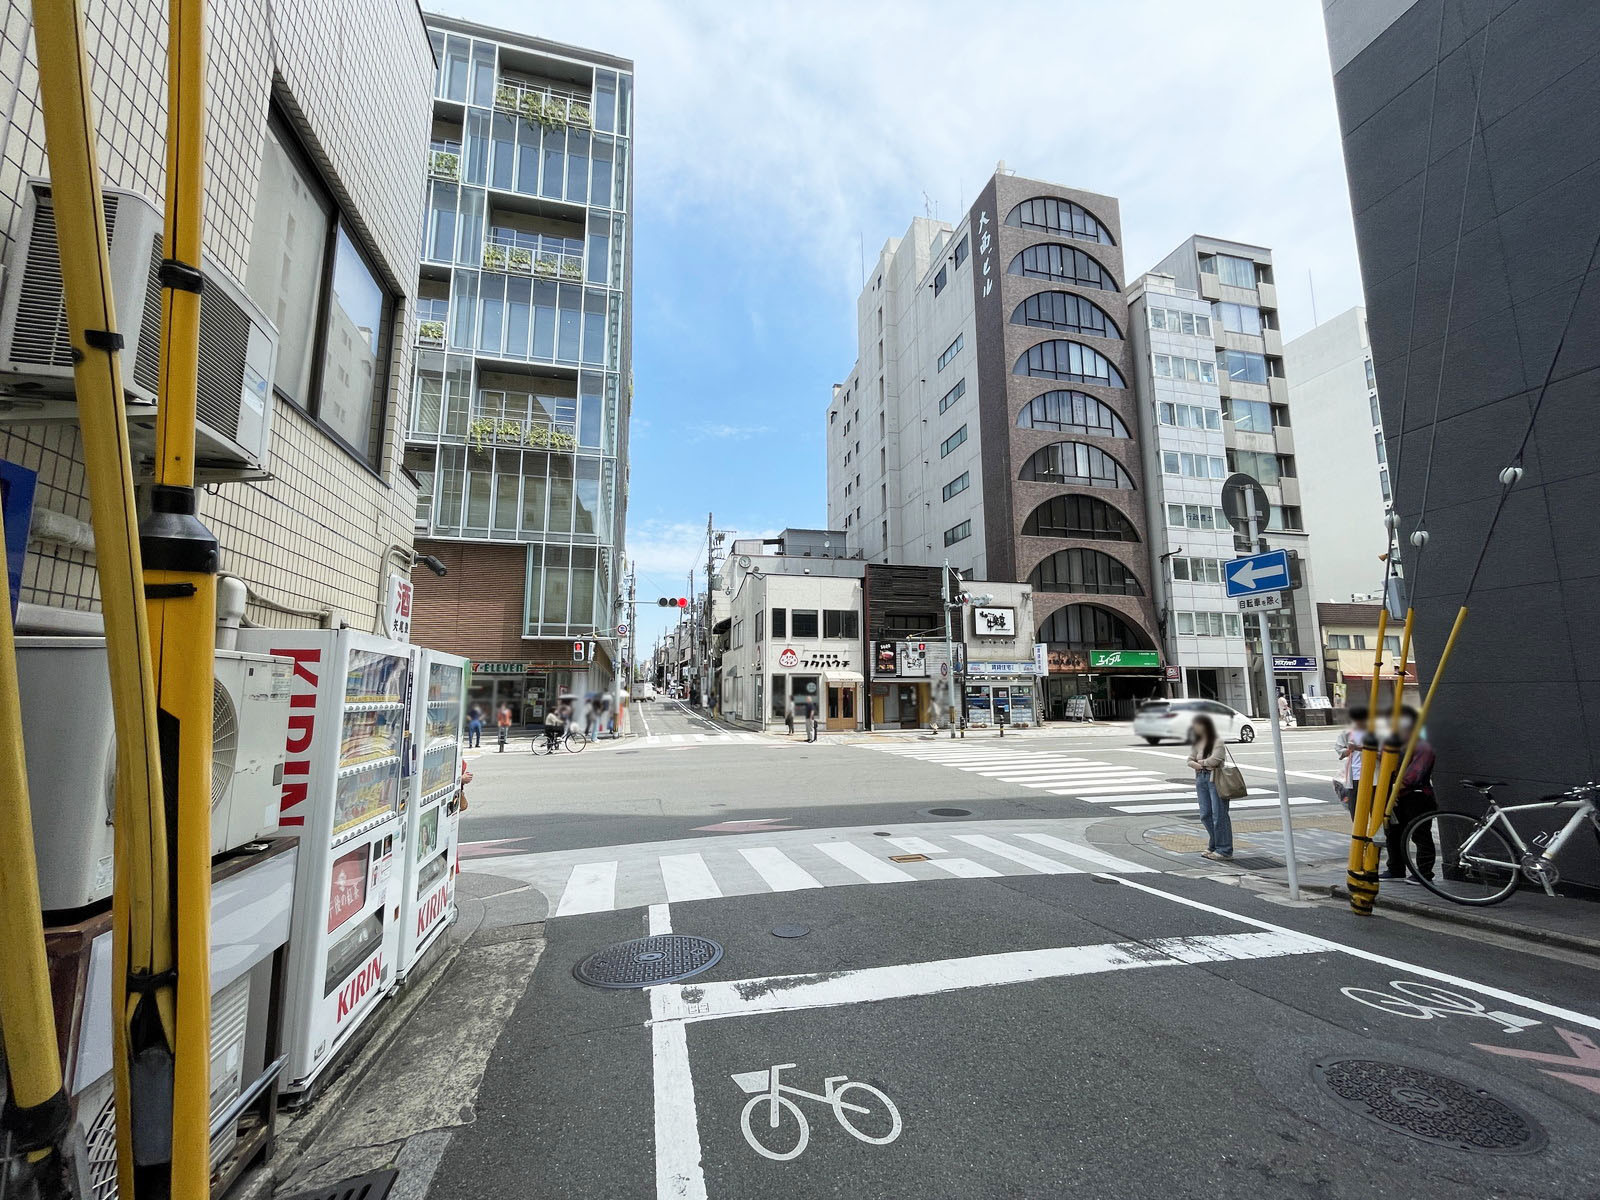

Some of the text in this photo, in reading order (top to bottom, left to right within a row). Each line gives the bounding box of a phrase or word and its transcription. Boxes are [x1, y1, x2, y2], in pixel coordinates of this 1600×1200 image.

[395, 581, 412, 618] 酒
[1239, 595, 1280, 609] 自転車を除く
[800, 660, 850, 668] フクハウチ
[417, 881, 448, 948] KIRIN
[337, 952, 382, 1025] KIRIN
